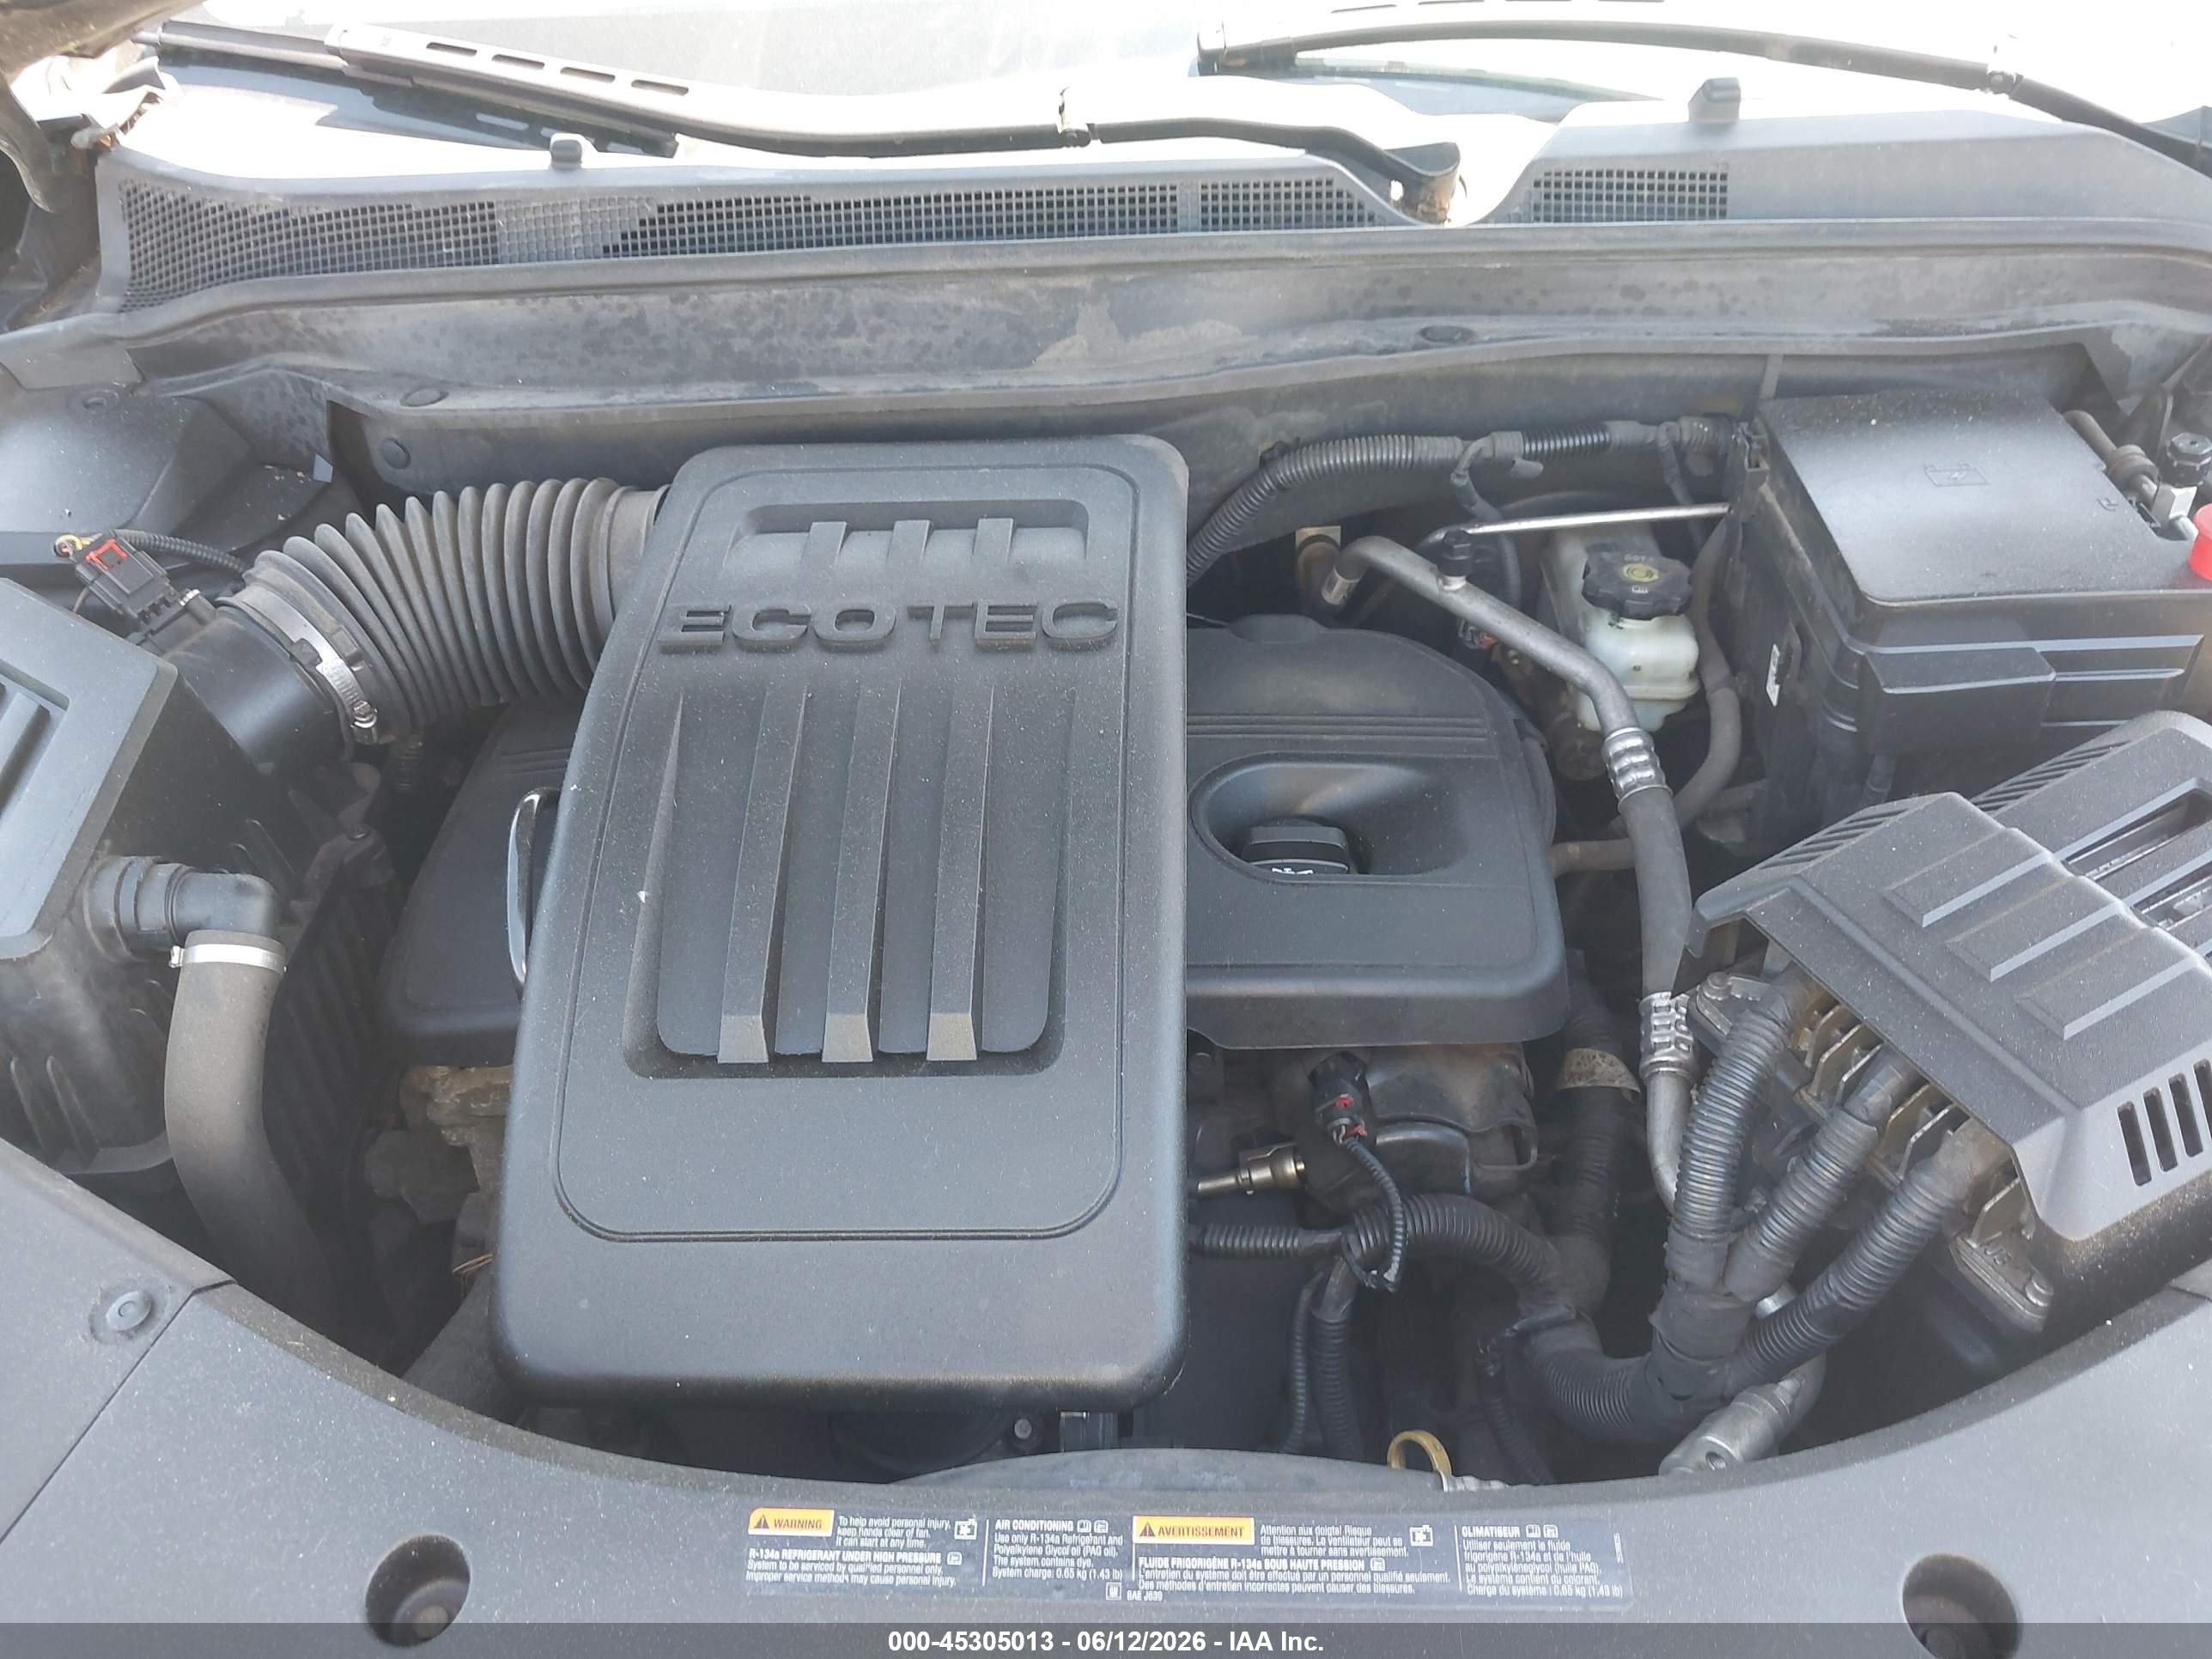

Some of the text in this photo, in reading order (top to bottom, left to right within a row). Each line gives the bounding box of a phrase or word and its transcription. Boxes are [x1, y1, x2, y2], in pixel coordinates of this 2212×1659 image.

[659, 603, 1117, 653] ECOTEC
[774, 1518, 822, 1528] WARNING
[839, 1516, 848, 1526] To
[850, 1516, 866, 1528] help
[868, 1516, 890, 1528] avoid
[891, 1518, 925, 1528] personal
[995, 1520, 1073, 1531] AIR CONDITIONING
[837, 1526, 856, 1537] keep
[859, 1527, 882, 1537] hands
[884, 1528, 904, 1538] clear
[905, 1528, 915, 1539] of
[1158, 1526, 1244, 1537] AVERTISSEMENT
[1260, 1524, 1296, 1536] Attention
[1298, 1525, 1312, 1535] aux
[1345, 1525, 1372, 1537] Risque
[1462, 1526, 1520, 1538] CLIMATISEUR
[843, 1537, 858, 1547] can
[860, 1537, 878, 1547] start
[879, 1538, 888, 1547] at
[890, 1539, 904, 1550] any
[994, 1533, 1123, 1546] Use only R-134a Refrigerant and
[1261, 1535, 1270, 1546] de
[1316, 1536, 1327, 1546] Le
[1329, 1536, 1370, 1547] ventilateur
[1373, 1537, 1389, 1548] peut
[1392, 1538, 1403, 1547] se
[1463, 1540, 1571, 1552] Utiliser seulement le fluide
[750, 1548, 942, 1564] R-134a REFRIGERANT UNDER HIGH PRESSURE
[994, 1543, 1042, 1556] Polyalkylene
[1045, 1545, 1069, 1557] Glycol
[1071, 1545, 1080, 1555] oil
[1083, 1546, 1102, 1558] (PAG
[1261, 1546, 1287, 1556] mettre
[1297, 1547, 1326, 1556] tourner
[1328, 1547, 1347, 1557] sans
[1464, 1551, 1508, 1563] frigorigène
[1510, 1552, 1541, 1562] R-134a
[1544, 1552, 1552, 1562] et
[1554, 1552, 1564, 1562] de
[748, 1560, 777, 1571] System
[780, 1561, 787, 1571] to
[788, 1561, 799, 1571] be
[801, 1562, 835, 1572] serviced
[836, 1563, 846, 1574] by
[848, 1563, 882, 1574] qualified
[884, 1564, 924, 1575] personnel
[994, 1554, 1007, 1565] The
[1010, 1555, 1039, 1568] system
[1041, 1556, 1074, 1567] contains
[1139, 1556, 1364, 1571] FLUIDE FRIGORIGÈNE R-134a SOUS HAUTE PRESSION
[993, 1566, 1022, 1579] System
[1077, 1568, 1087, 1581] kg
[1112, 1570, 1123, 1580] lb)
[1465, 1564, 1475, 1573] au
[1554, 1563, 1577, 1574] (huile
[746, 1571, 782, 1583] Improper
[783, 1572, 812, 1582] service
[814, 1573, 848, 1583] methods
[850, 1574, 868, 1585] may
[871, 1576, 894, 1585] cause
[896, 1576, 930, 1587] personal
[1139, 1568, 1181, 1580] L'entretien
[1183, 1569, 1194, 1579] du
[1195, 1569, 1230, 1582] système
[1231, 1569, 1247, 1580] doit
[1249, 1569, 1265, 1581] être
[1267, 1571, 1300, 1582] effectué
[1303, 1572, 1316, 1583] par
[1318, 1572, 1328, 1582] un
[1331, 1571, 1371, 1584] personnel
[1374, 1572, 1402, 1584] qualifié
[1466, 1574, 1476, 1583] Le
[1479, 1574, 1513, 1586] système
[1516, 1574, 1549, 1584] contient
[1551, 1574, 1561, 1584] du
[1139, 1580, 1155, 1590] Des
[1157, 1580, 1196, 1591] méthodes
[1199, 1581, 1242, 1592] d'entretien
[1244, 1582, 1290, 1593] incorrectes
[1291, 1583, 1325, 1595] peuvent
[1327, 1583, 1354, 1594] causer
[1356, 1583, 1371, 1594] des
[1468, 1584, 1497, 1597] Charge
[1499, 1585, 1510, 1595] du
[1512, 1584, 1546, 1597] système
[1576, 1585, 1586, 1598] kg
[1612, 1585, 1623, 1598] lb)
